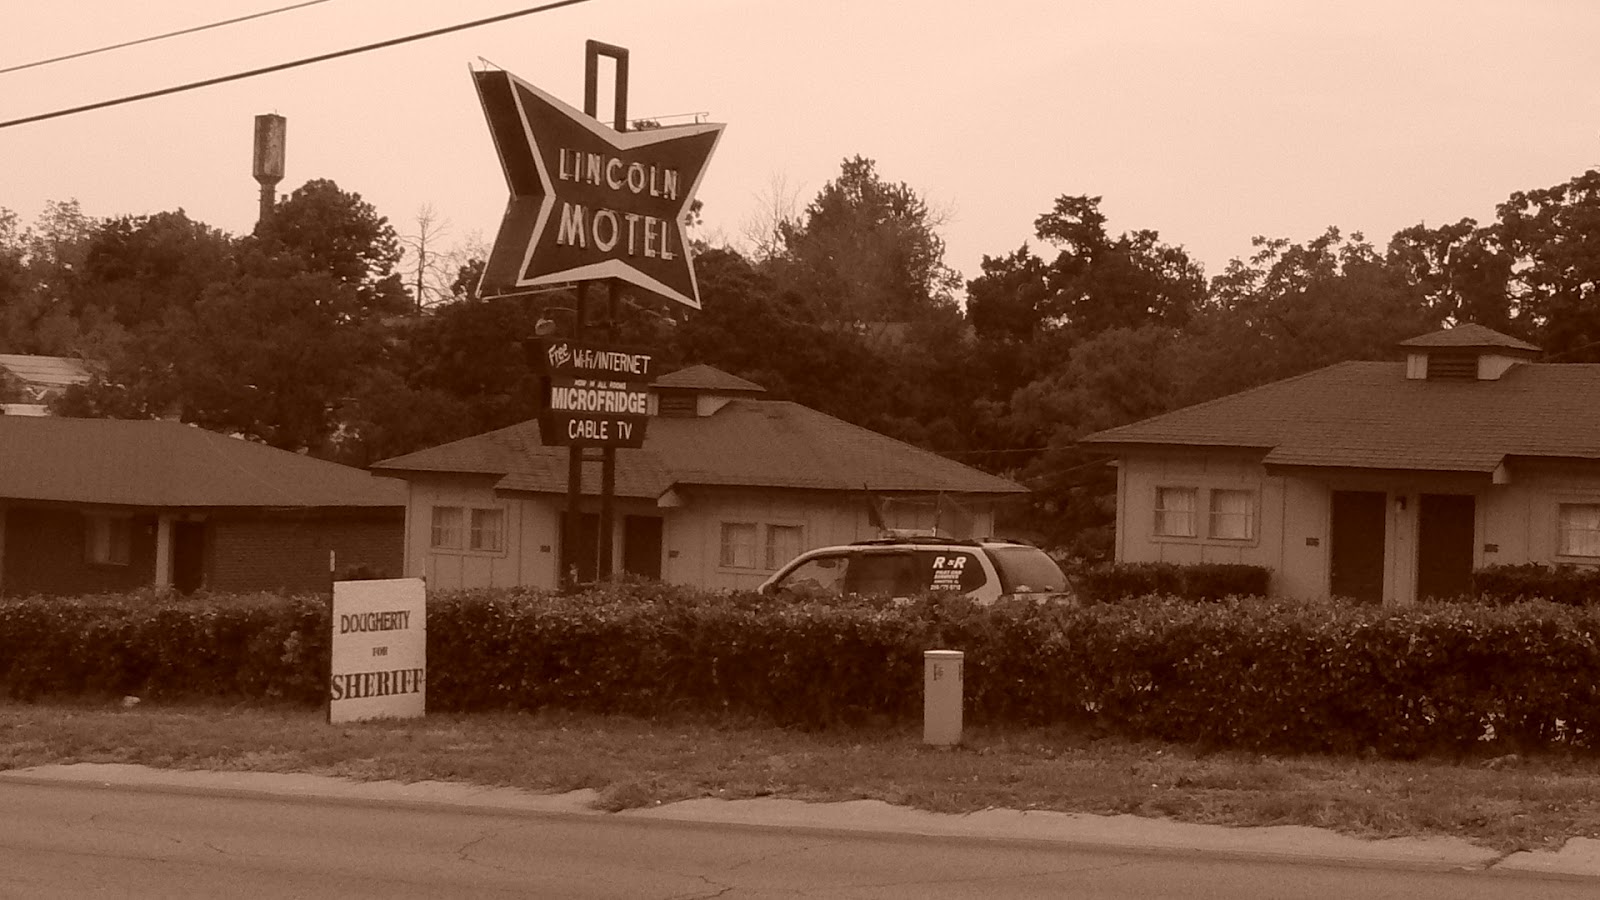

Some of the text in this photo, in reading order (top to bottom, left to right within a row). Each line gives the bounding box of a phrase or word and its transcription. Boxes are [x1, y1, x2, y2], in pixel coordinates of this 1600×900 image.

[559, 148, 678, 200] LINCOLN
[557, 202, 677, 260] MOTEL
[548, 343, 571, 368] Free
[551, 386, 646, 414] MICROFRIDGE
[568, 419, 633, 440] CABLE TV
[340, 610, 411, 634] DOUGHERTY
[372, 646, 388, 657] FOR
[331, 668, 424, 700] SHERIFF
